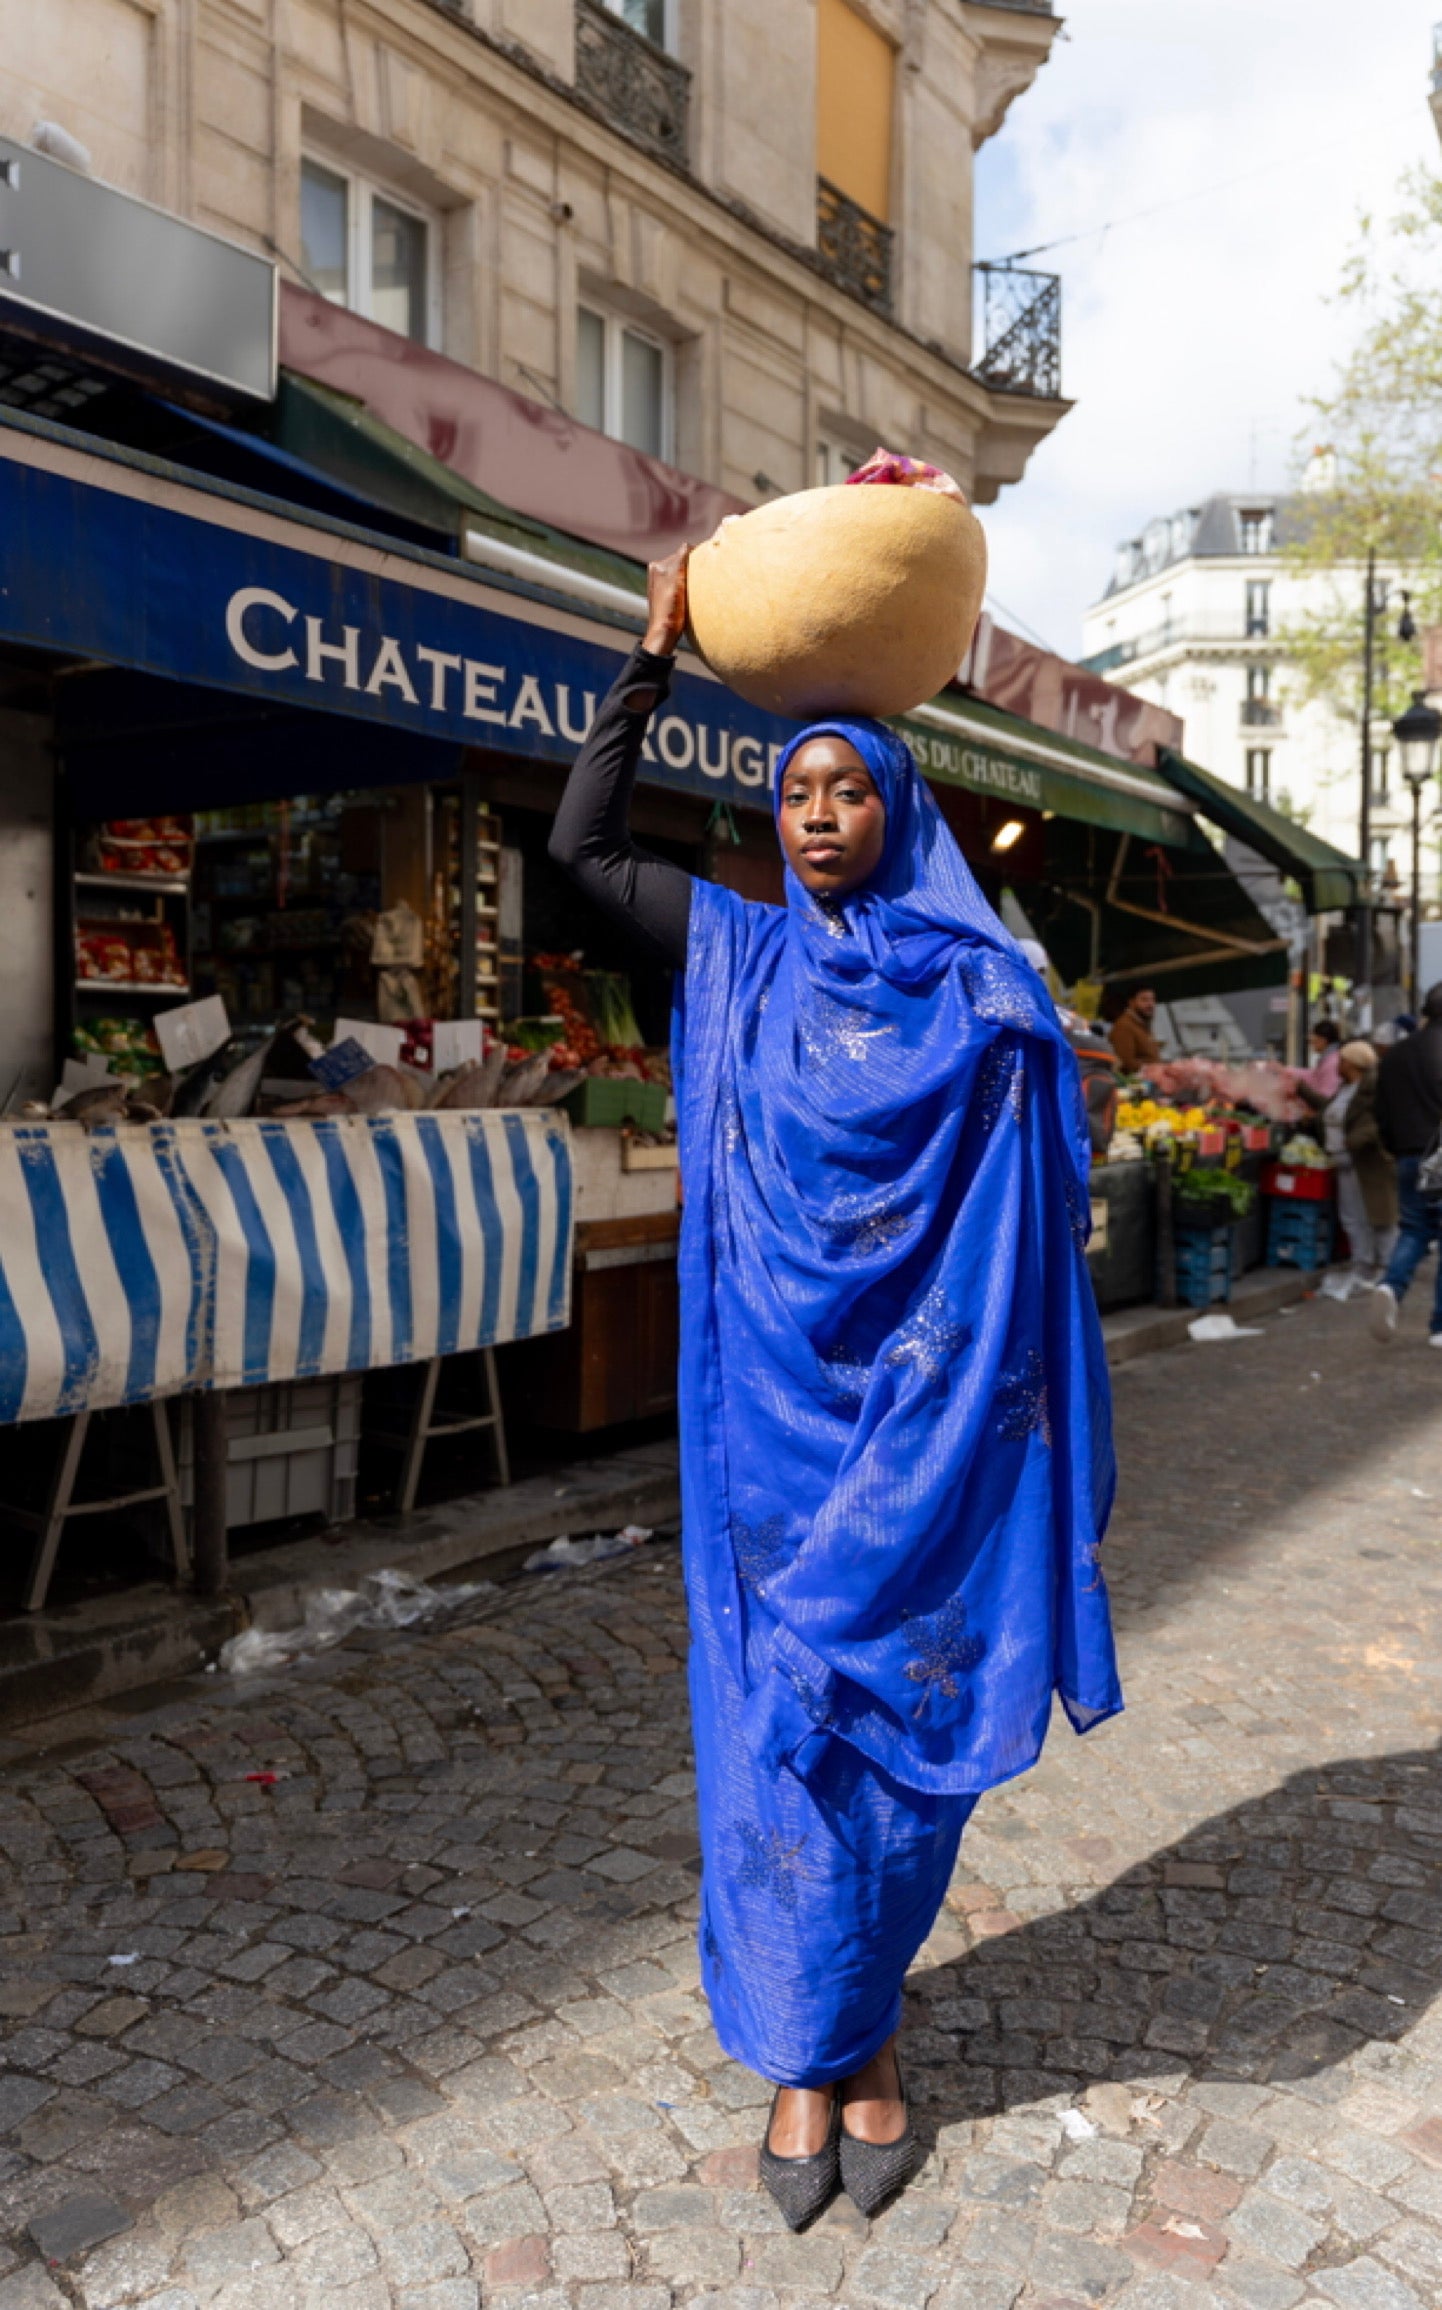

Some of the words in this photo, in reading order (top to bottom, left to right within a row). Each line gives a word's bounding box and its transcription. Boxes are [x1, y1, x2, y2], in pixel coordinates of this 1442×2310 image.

[225, 587, 596, 743] CHATEAU
[930, 739, 960, 773] DU
[961, 749, 1041, 799] CHATEAU
